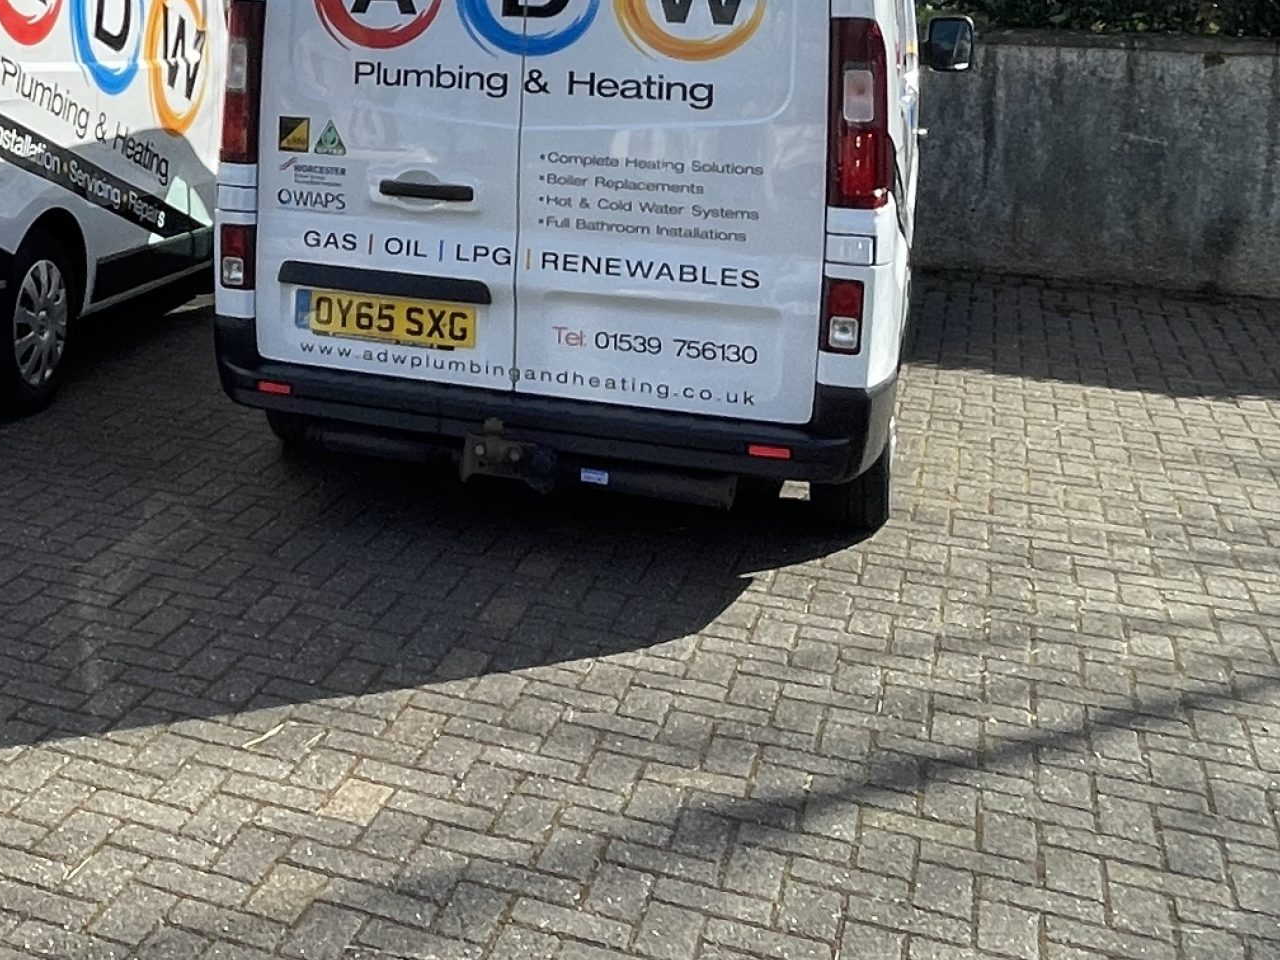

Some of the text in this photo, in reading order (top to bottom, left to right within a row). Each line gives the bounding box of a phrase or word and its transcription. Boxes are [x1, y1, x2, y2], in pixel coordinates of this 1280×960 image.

[354, 61, 714, 109] Plumbing & Heating
[1, 56, 169, 186] Plumbing & Heating
[547, 151, 764, 176] Complete Heating Solutions
[69, 160, 120, 209] Servicing
[128, 191, 166, 228] Repairs
[547, 173, 704, 194] Boiler Replacements
[546, 195, 759, 221] Hot & Cold Water Systems
[546, 216, 746, 242] Full Bathroom Installations
[304, 230, 760, 289] GAS OIL LPG RENEWABLES
[315, 296, 468, 341] OY65 SXG
[594, 331, 662, 355] 01539
[673, 339, 757, 364] 756130
